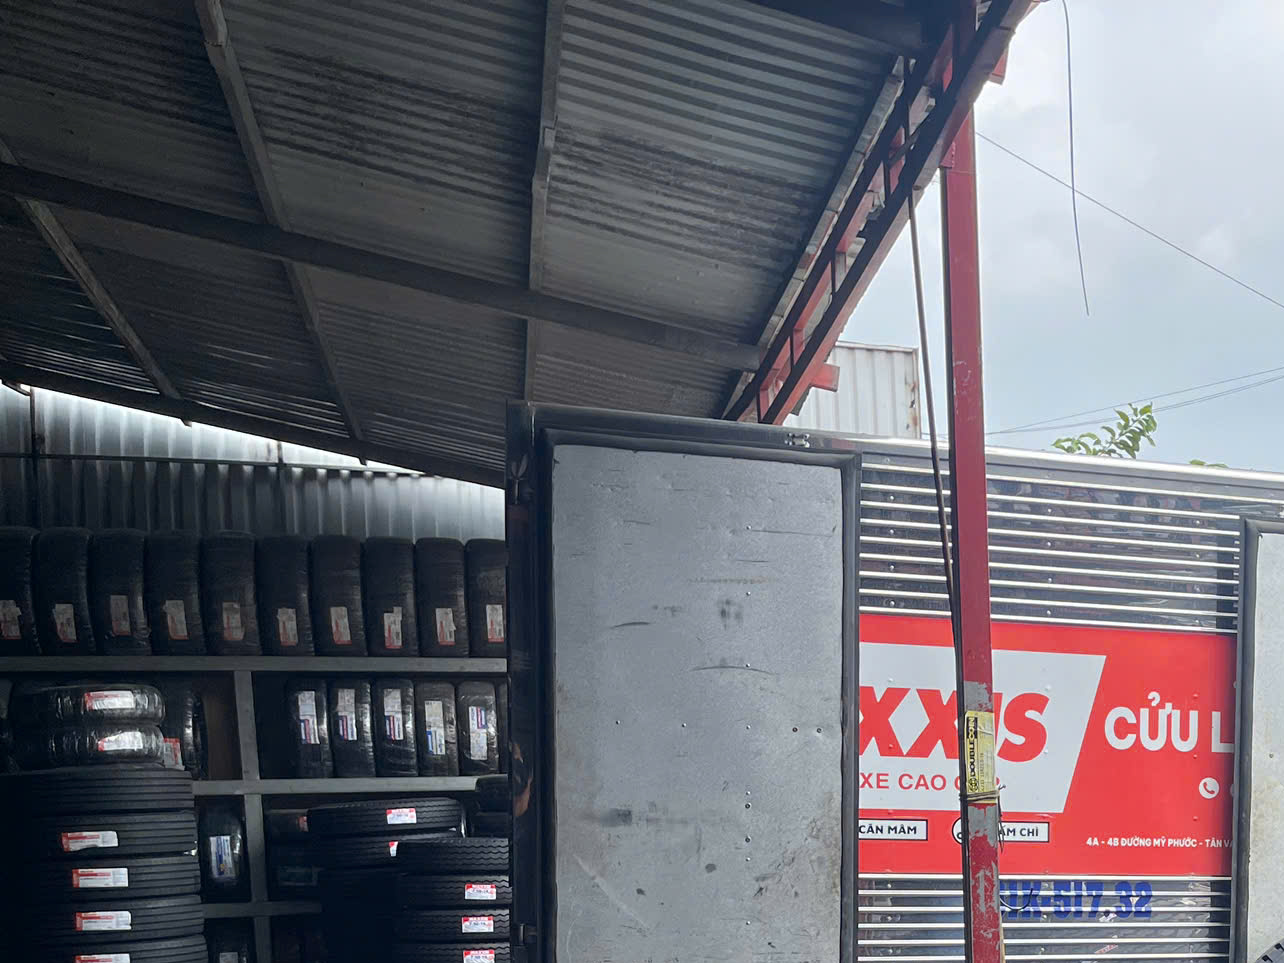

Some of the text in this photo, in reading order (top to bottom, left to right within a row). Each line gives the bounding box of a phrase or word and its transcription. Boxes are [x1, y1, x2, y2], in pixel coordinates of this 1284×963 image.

[1104, 691, 1199, 753] CỬU
[859, 772, 889, 790] XE
[898, 773, 947, 792] CAO
[1085, 837, 1099, 847] 4A
[1107, 837, 1119, 847] 4B
[1120, 836, 1152, 847] ĐƯỜNG
[1167, 837, 1198, 848] PHƯỚC
[1205, 837, 1223, 848] TÂN
